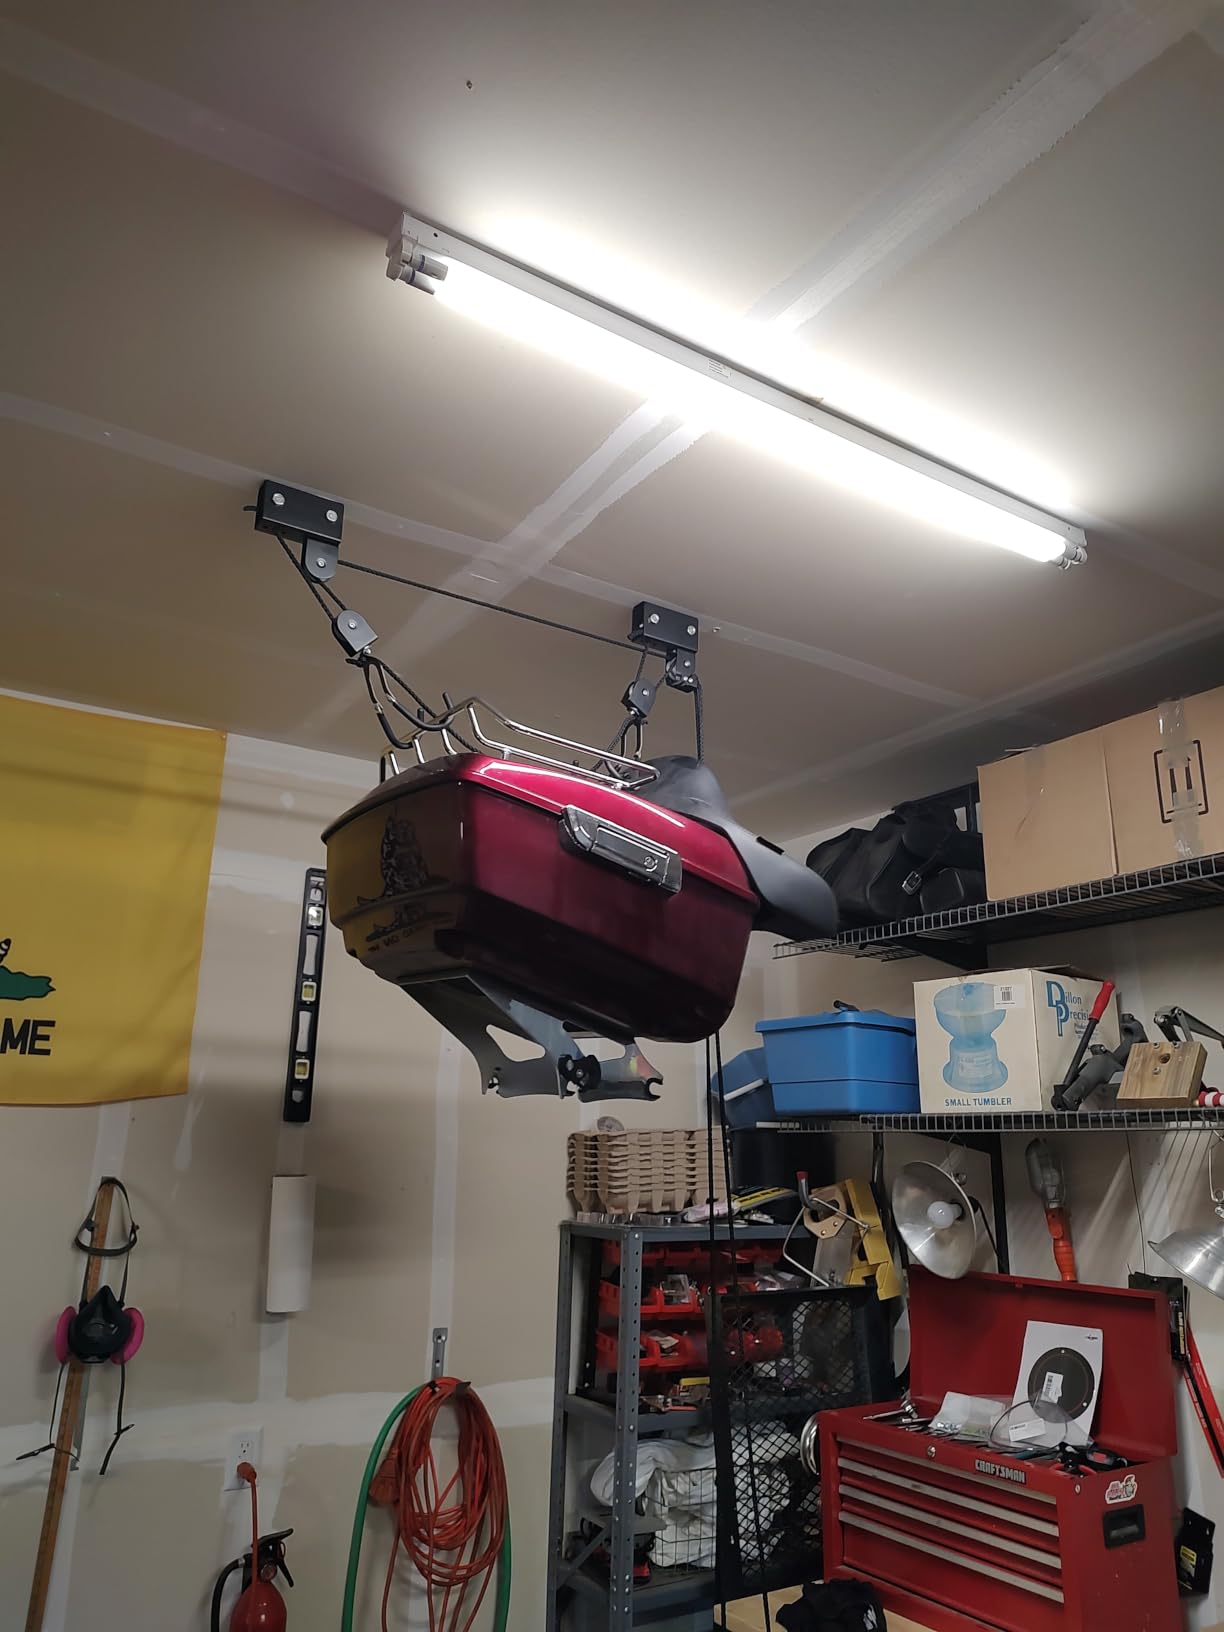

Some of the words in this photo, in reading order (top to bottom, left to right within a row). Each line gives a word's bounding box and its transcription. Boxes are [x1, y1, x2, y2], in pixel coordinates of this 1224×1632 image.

[1046, 980, 1082, 1008] Dillon
[1055, 1000, 1090, 1037] Precisi
[0, 1017, 56, 1056] ME
[945, 1098, 971, 1107] SMALL
[973, 1097, 1012, 1106] TUMBLER
[975, 1459, 1025, 1483] CRAFTSMAN
